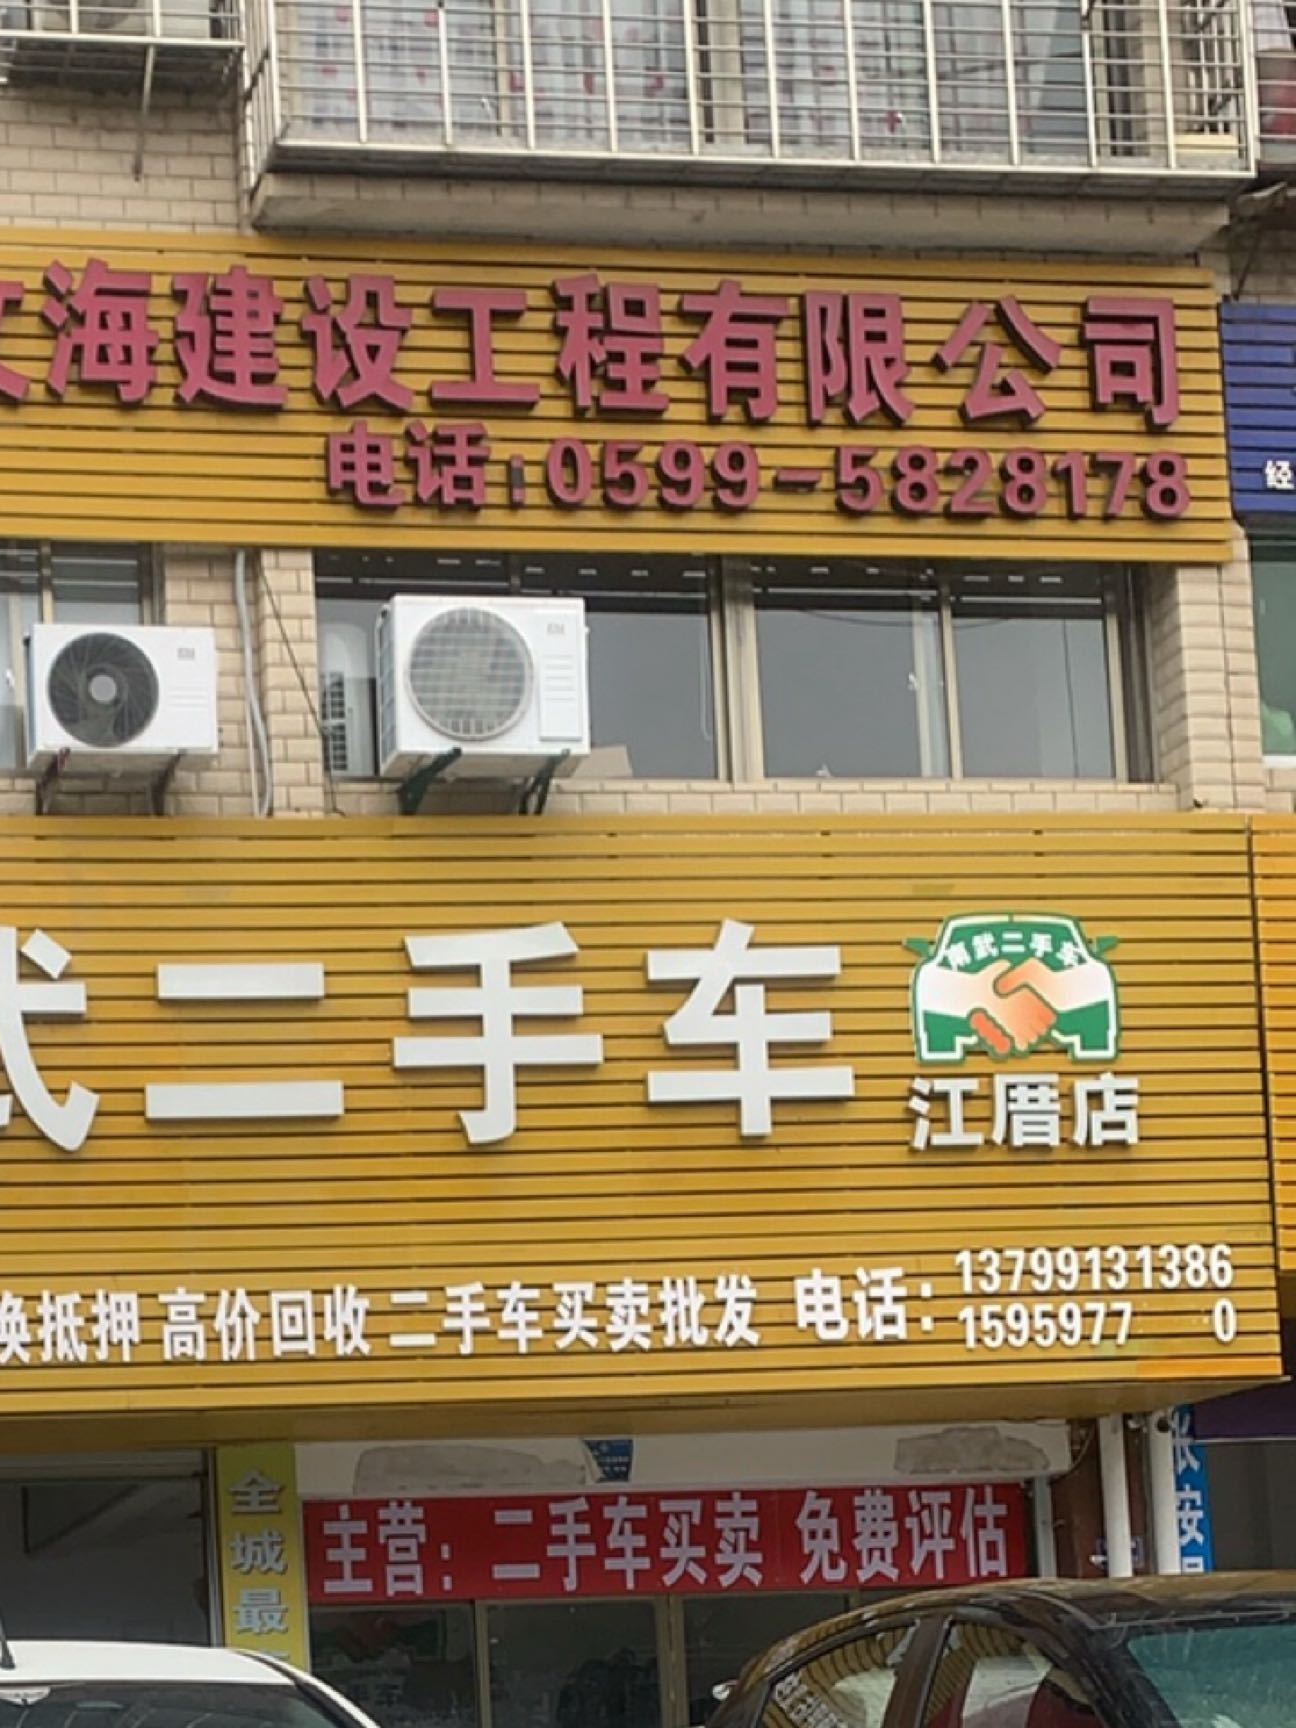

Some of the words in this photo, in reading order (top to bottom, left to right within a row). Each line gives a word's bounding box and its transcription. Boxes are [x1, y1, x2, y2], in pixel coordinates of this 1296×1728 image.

[909, 1071, 1139, 1150] 江厝店
[157, 1285, 370, 1361] 高价回收
[386, 1275, 761, 1353] 二手车买卖批发
[794, 1266, 934, 1342] 电话：
[955, 1244, 1233, 1293] 13799131386
[229, 1467, 289, 1661] 全城最
[323, 1500, 453, 1597] 主营：
[492, 1492, 763, 1591] 二手车买卖
[796, 1487, 1009, 1584] 免费评估
